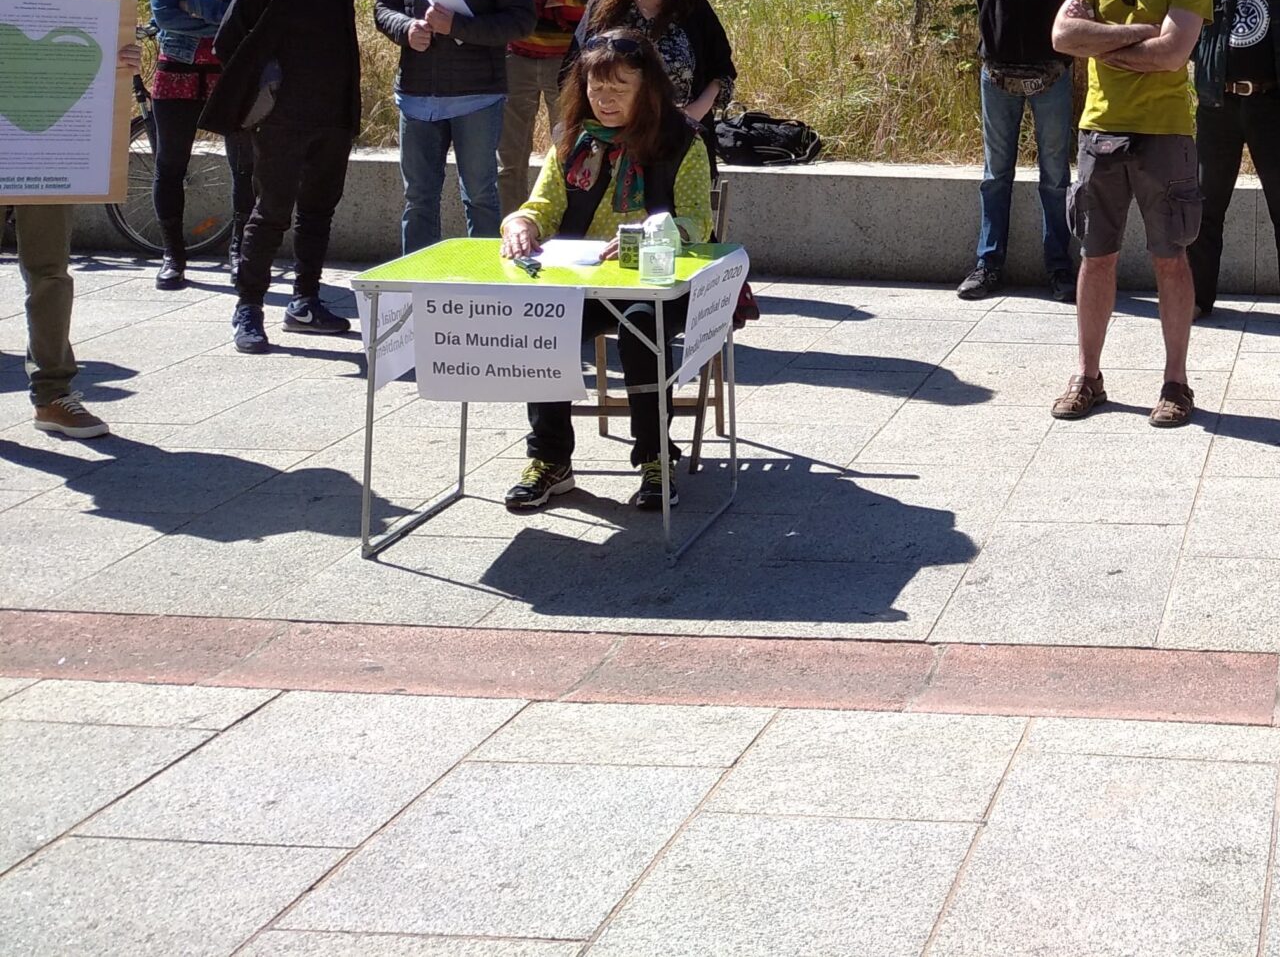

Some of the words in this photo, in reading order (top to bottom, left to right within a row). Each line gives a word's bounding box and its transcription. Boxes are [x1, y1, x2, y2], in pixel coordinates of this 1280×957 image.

[721, 264, 743, 283] 2020
[426, 300, 437, 314] 5
[442, 300, 464, 315] de
[468, 300, 513, 319] junio
[523, 302, 566, 318] 2020
[720, 292, 731, 308] del
[434, 331, 461, 346] Día
[465, 333, 528, 349] Mundial
[533, 335, 557, 350] del
[432, 362, 480, 376] Medio
[485, 363, 562, 379] Ambiente
